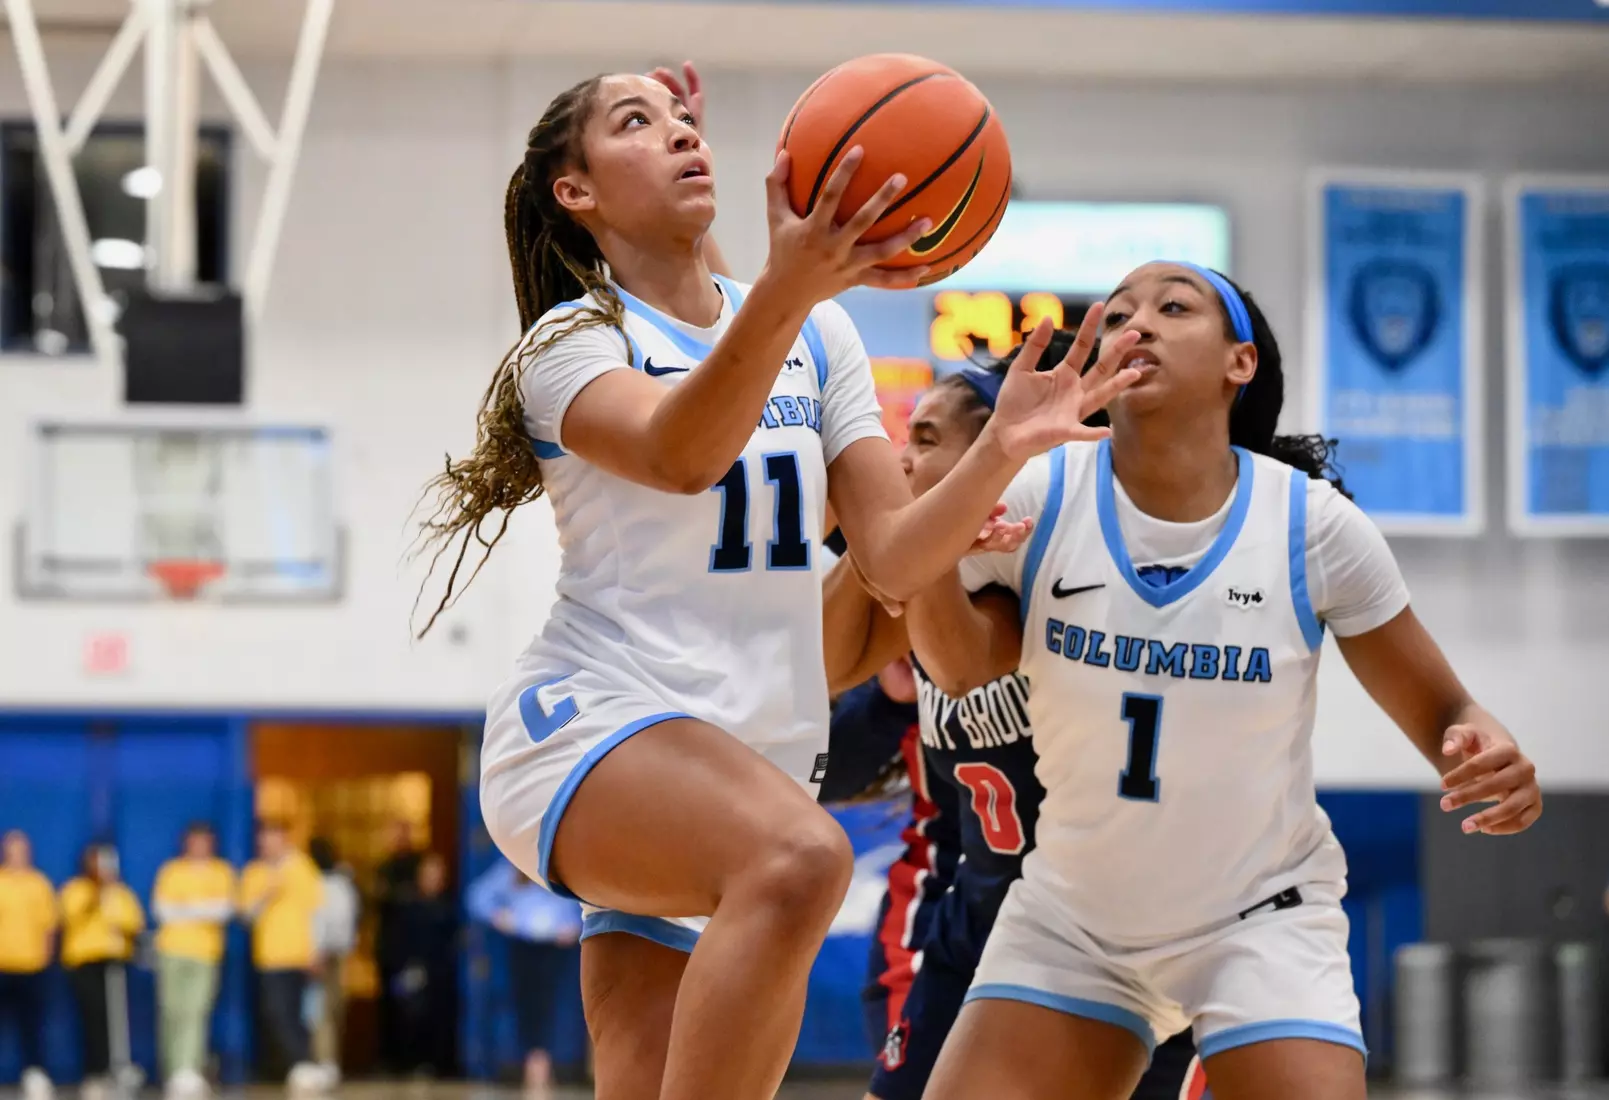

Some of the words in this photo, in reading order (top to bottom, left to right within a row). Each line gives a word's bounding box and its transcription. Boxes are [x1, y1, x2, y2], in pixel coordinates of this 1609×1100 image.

[708, 451, 811, 573] 11
[1228, 588, 1251, 605] Ivy
[1045, 617, 1272, 683] COLUMBIA
[957, 673, 1033, 749] BROO
[1117, 692, 1164, 803] 1
[954, 762, 1025, 854] 0
